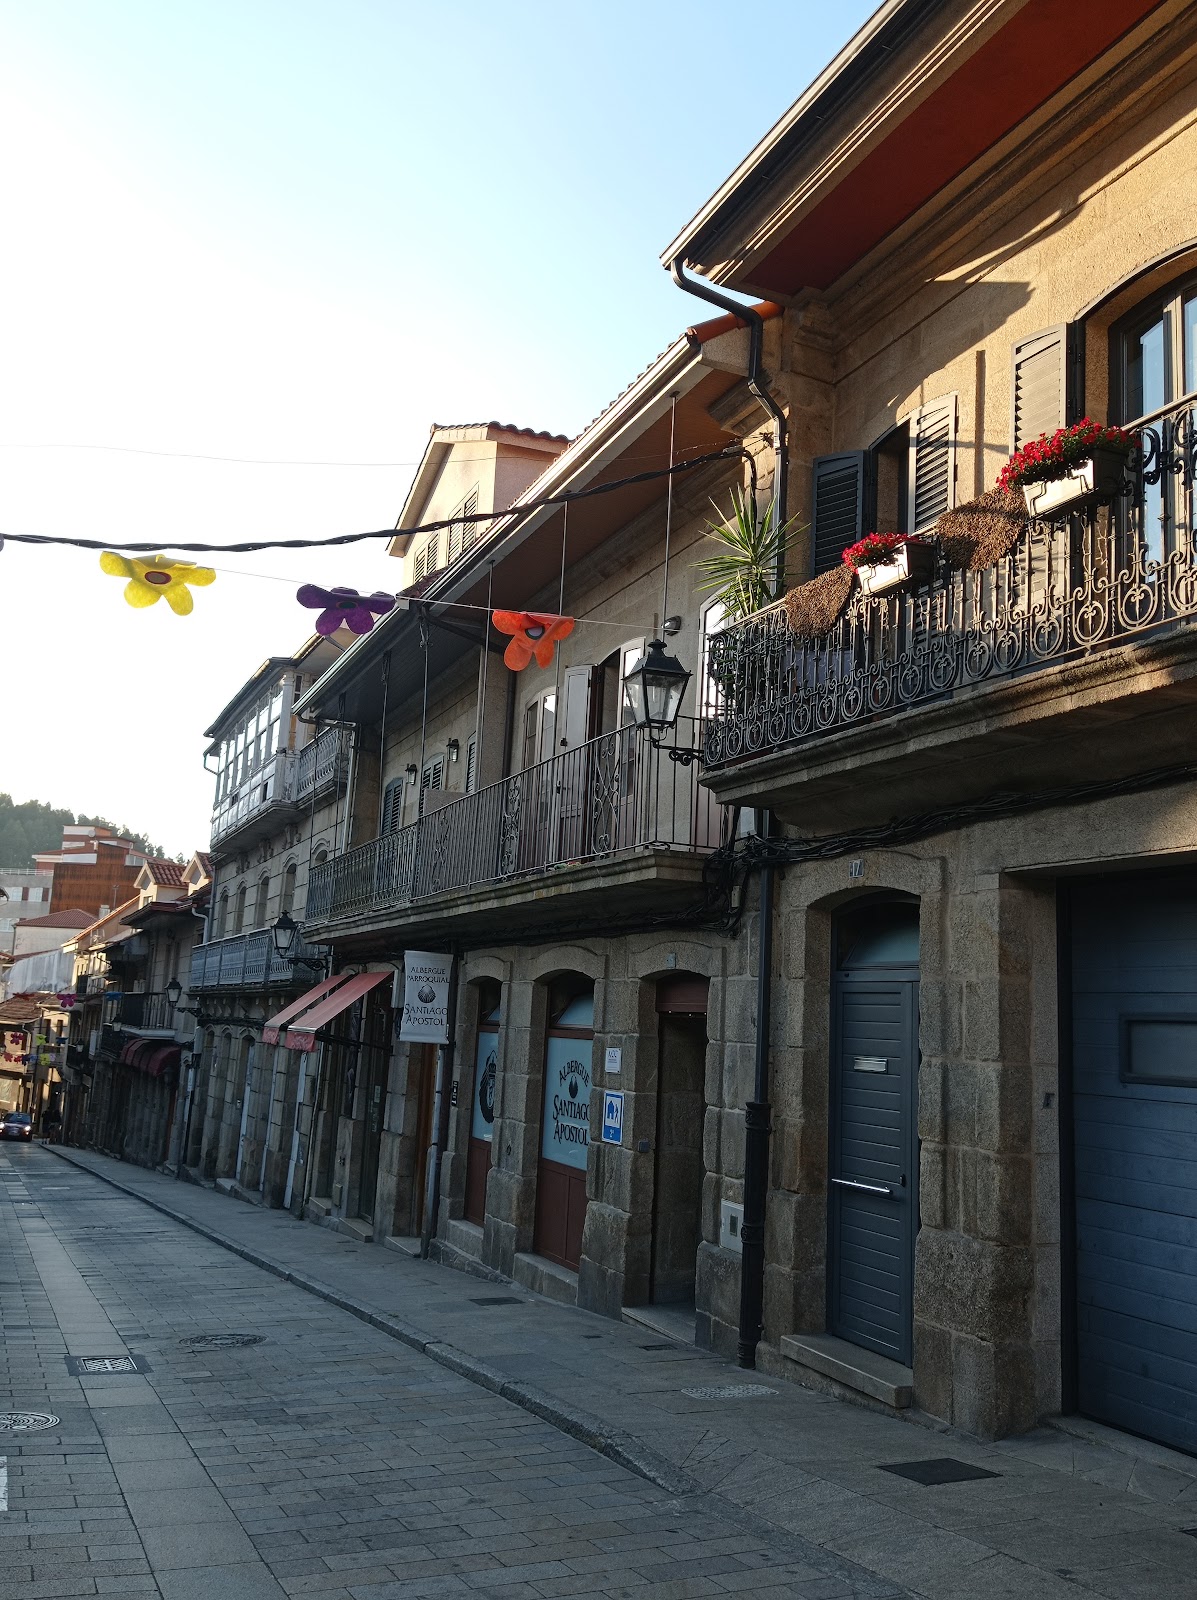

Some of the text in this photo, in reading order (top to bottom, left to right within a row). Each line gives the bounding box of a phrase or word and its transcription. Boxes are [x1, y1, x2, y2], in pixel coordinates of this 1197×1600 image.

[410, 966, 446, 975] ALBERGUE
[407, 975, 450, 984] PARROQUIAL
[404, 1003, 448, 1016] SANTIAGO
[405, 1014, 445, 1026] APOSTOL
[559, 1060, 590, 1087] ALBERGUE
[553, 1120, 589, 1146] APOSTOL
